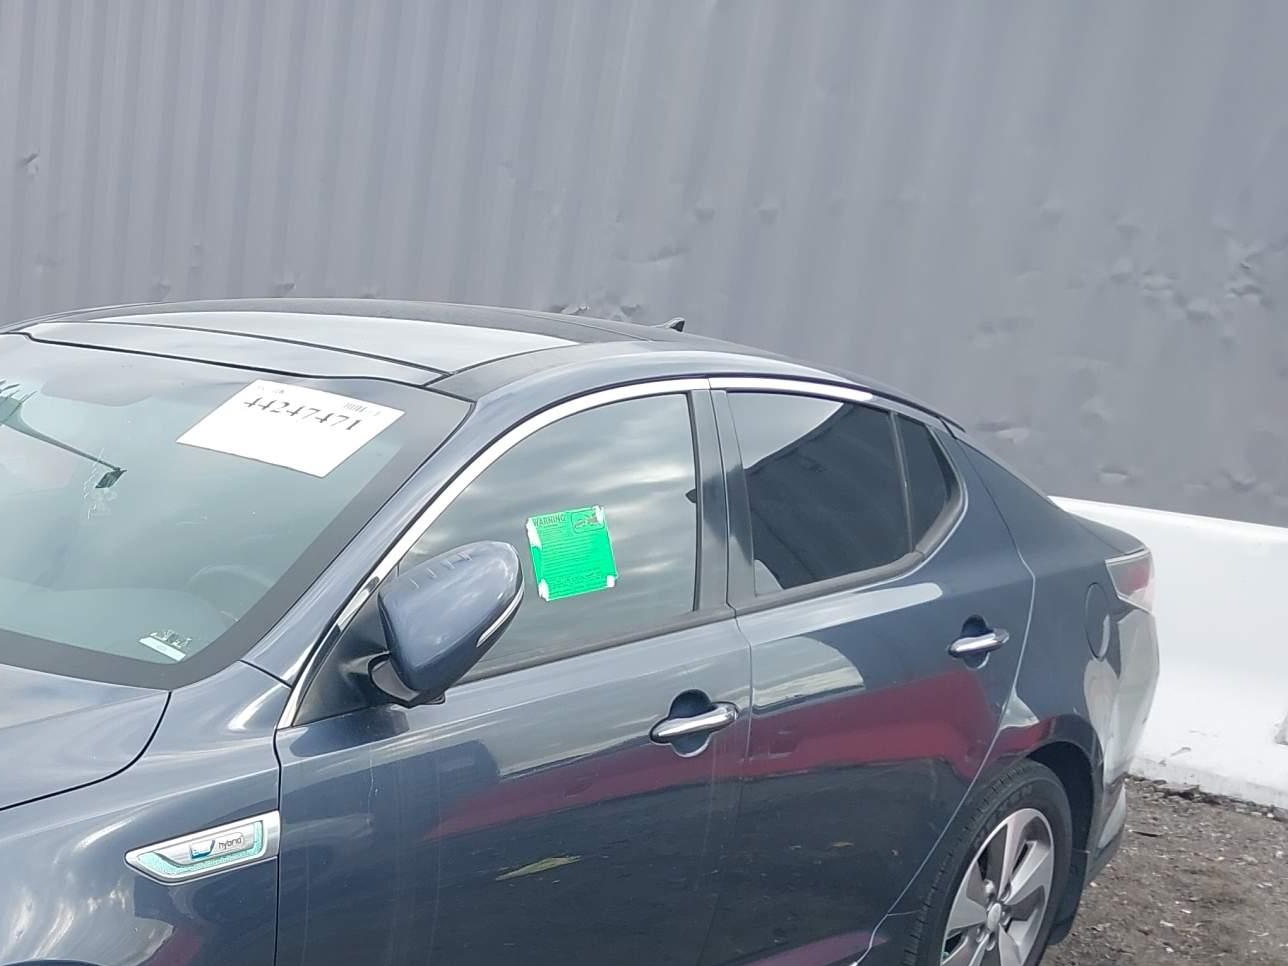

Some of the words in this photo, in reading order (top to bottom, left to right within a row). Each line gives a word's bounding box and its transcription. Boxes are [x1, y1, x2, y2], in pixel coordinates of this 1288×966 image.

[243, 396, 363, 431] 44247471
[533, 512, 567, 528] WARNING
[218, 835, 243, 850] hybrid
